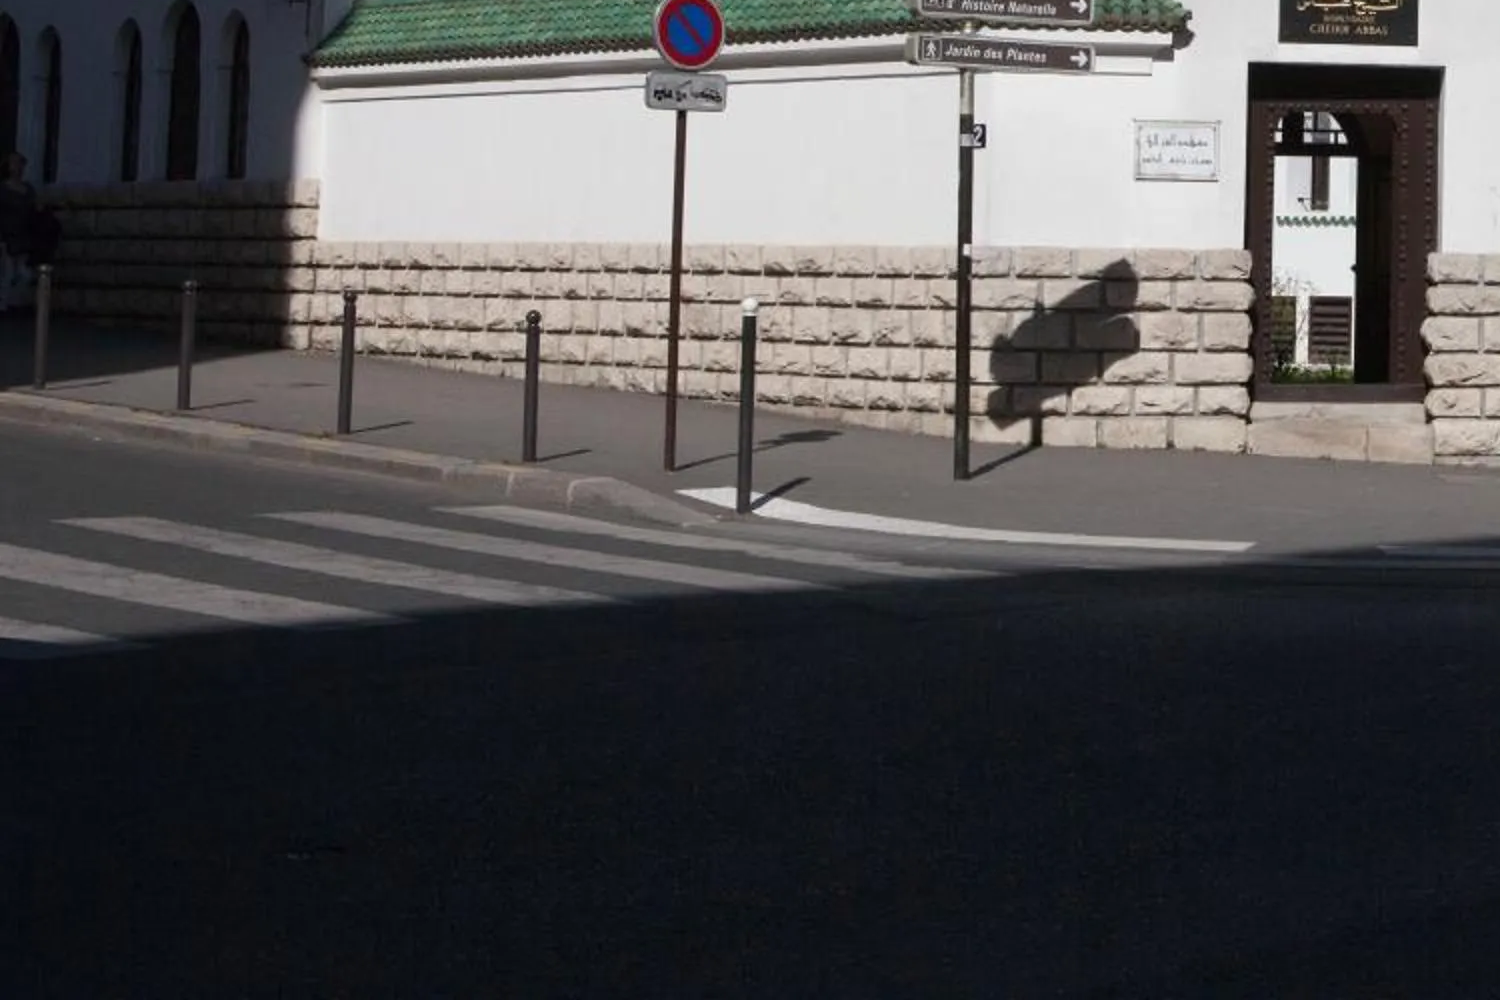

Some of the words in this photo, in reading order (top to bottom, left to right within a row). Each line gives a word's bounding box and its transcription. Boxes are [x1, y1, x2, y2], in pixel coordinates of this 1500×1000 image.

[961, 0, 1005, 12] Histoire
[944, 44, 981, 58] Jardin
[983, 47, 1002, 60] des
[1005, 49, 1047, 63] Plantes
